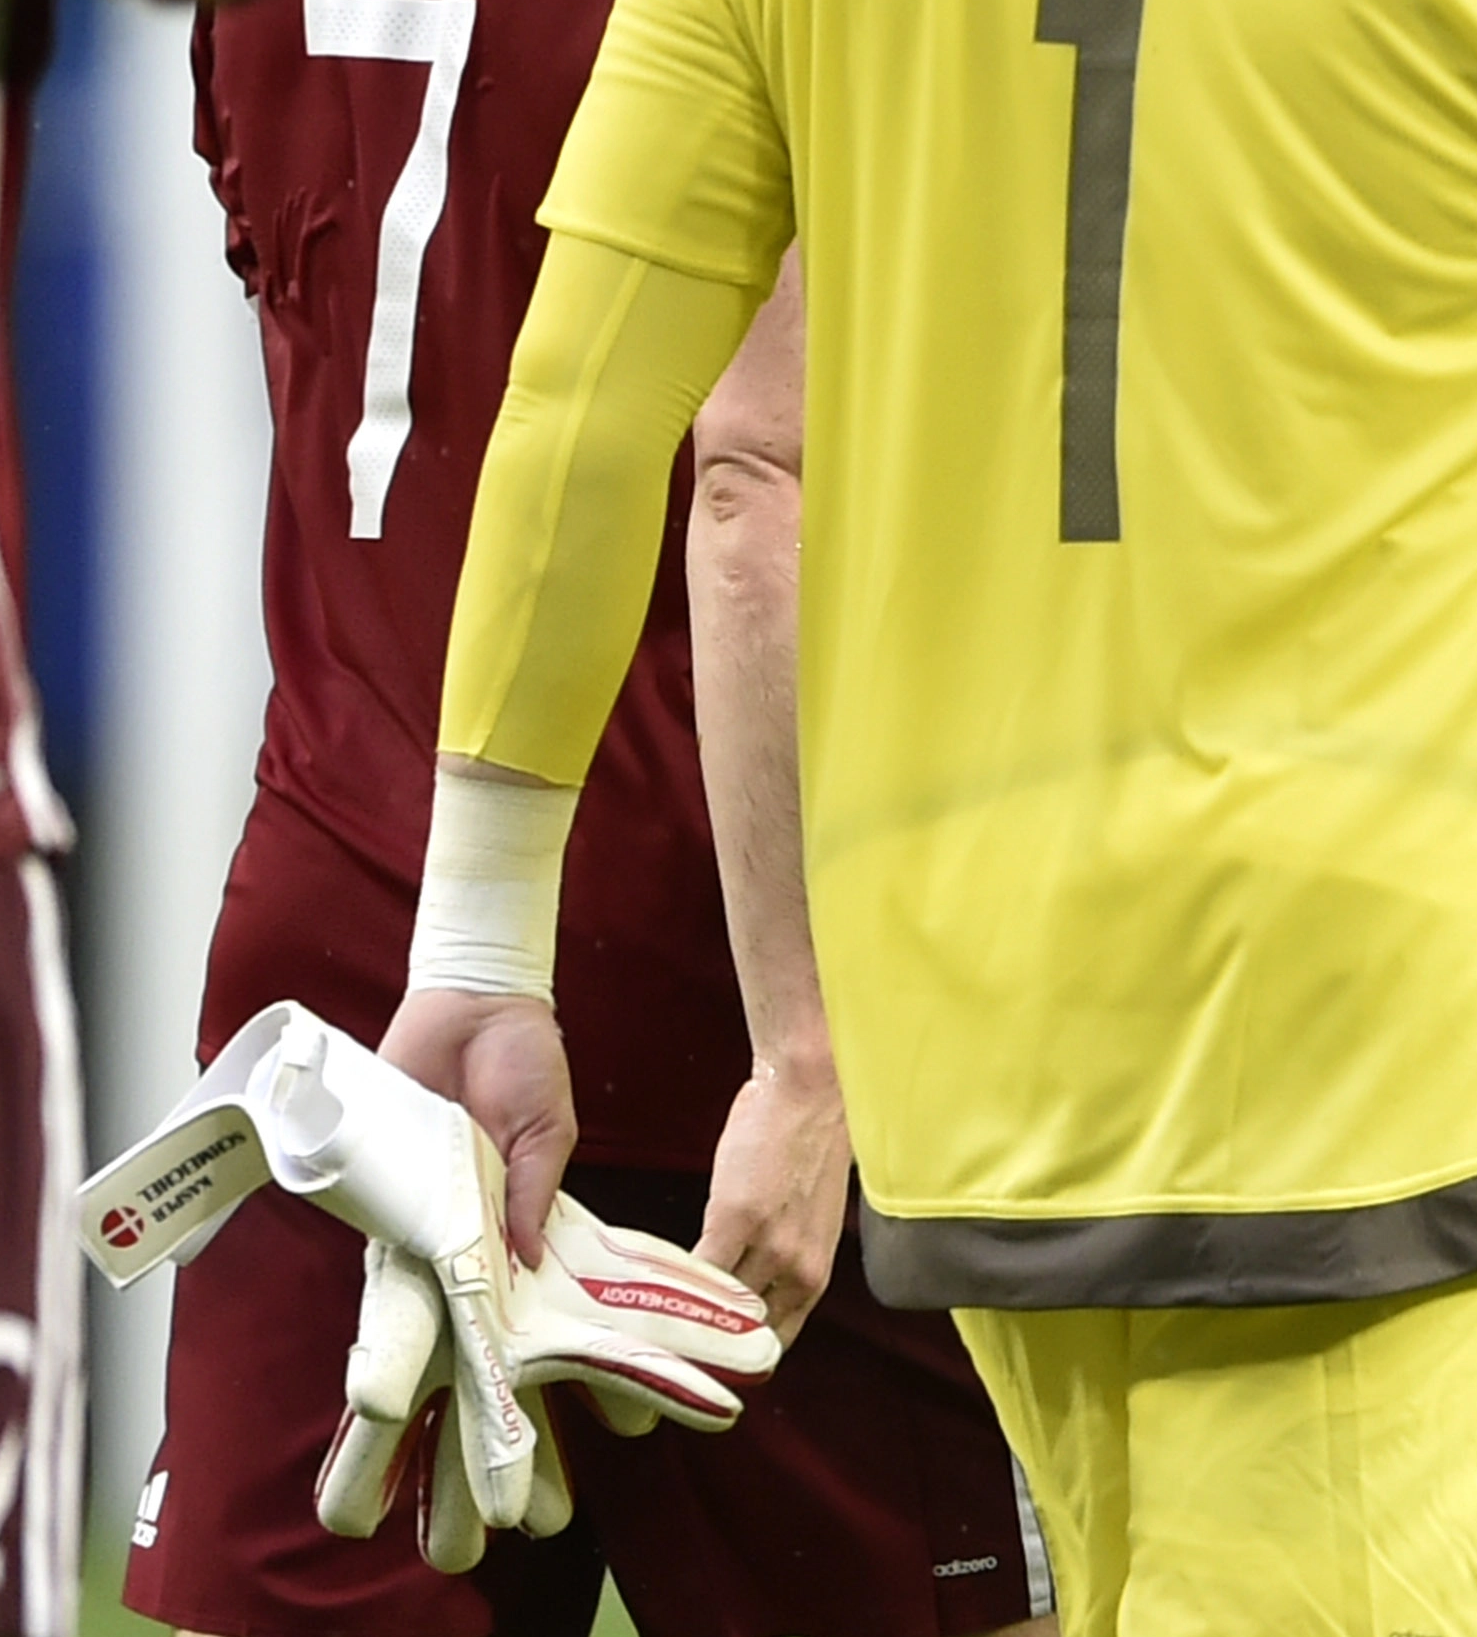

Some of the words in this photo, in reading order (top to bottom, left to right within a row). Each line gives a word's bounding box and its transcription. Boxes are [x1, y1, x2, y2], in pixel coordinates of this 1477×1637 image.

[137, 1130, 247, 1204] SCHMEICHEL
[150, 1174, 213, 1223] KASPER
[932, 1555, 998, 1578] adizero
